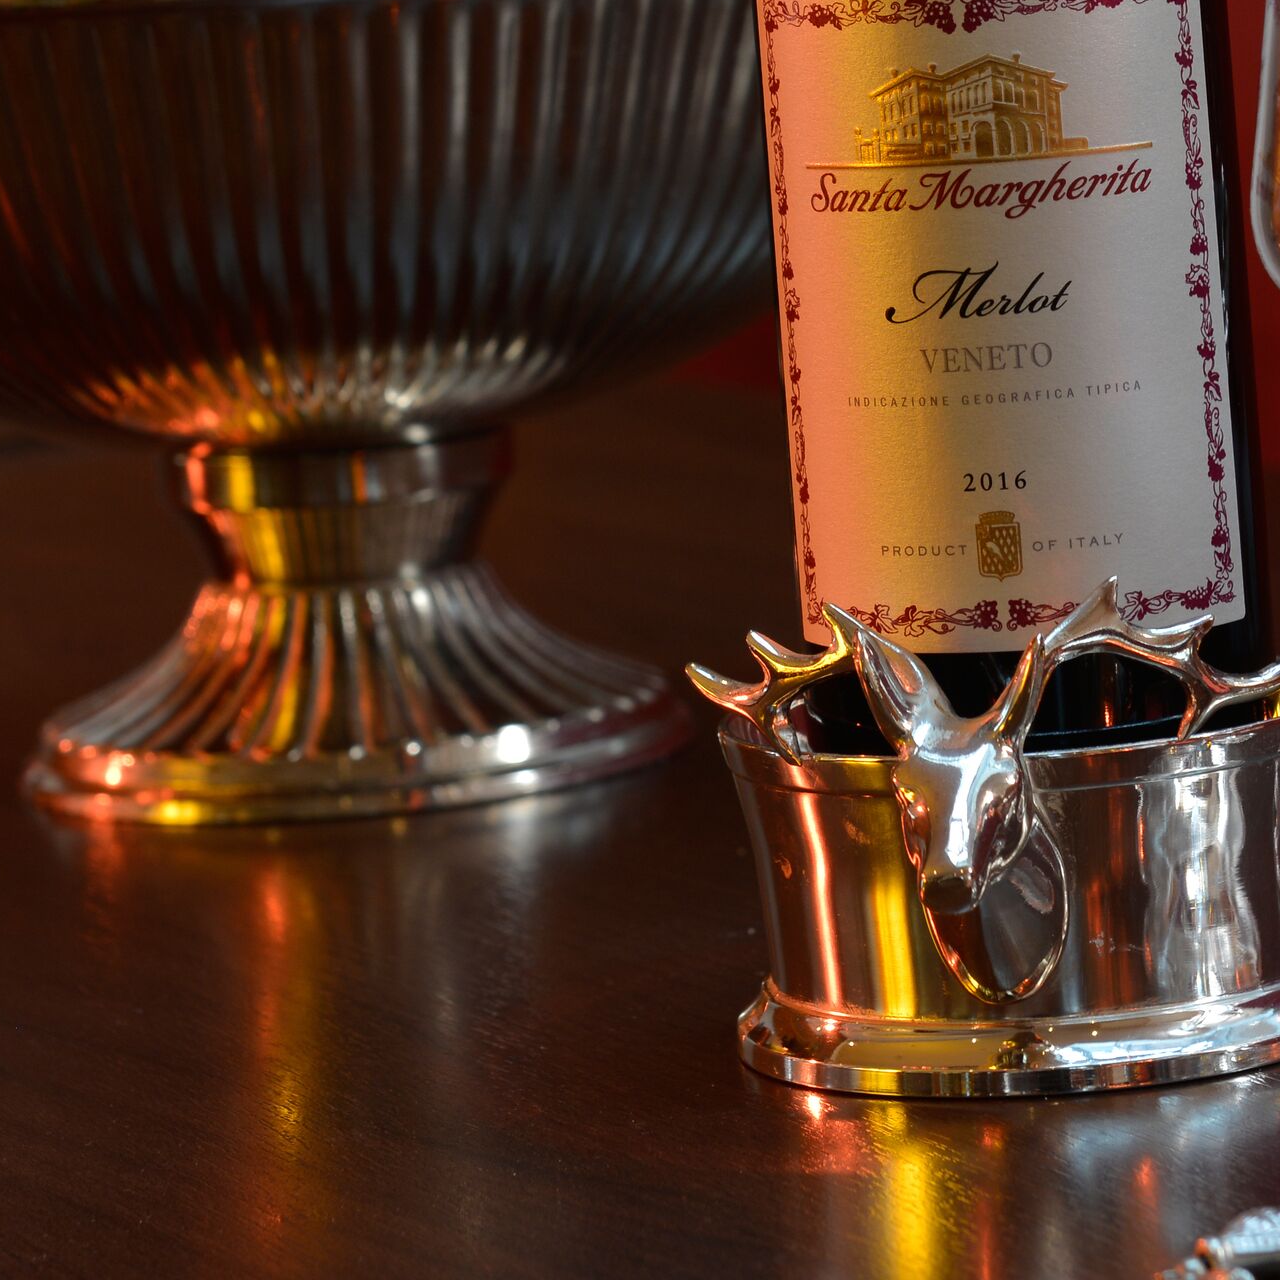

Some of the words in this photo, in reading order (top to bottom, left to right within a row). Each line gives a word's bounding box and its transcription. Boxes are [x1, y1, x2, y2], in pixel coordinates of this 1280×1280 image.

[811, 172, 906, 213] Santa
[908, 158, 1152, 219] Margherita
[884, 260, 1073, 324] Merlot
[919, 341, 1054, 375] VENETO
[847, 395, 950, 408] INDICAZIONE
[961, 388, 1076, 406] GEOGRAFICA
[1086, 380, 1142, 396] TIPICA
[963, 470, 1028, 493] 2016
[881, 544, 968, 557] PRODUCT
[1032, 540, 1059, 553] OF
[1069, 533, 1124, 549] ITALY
